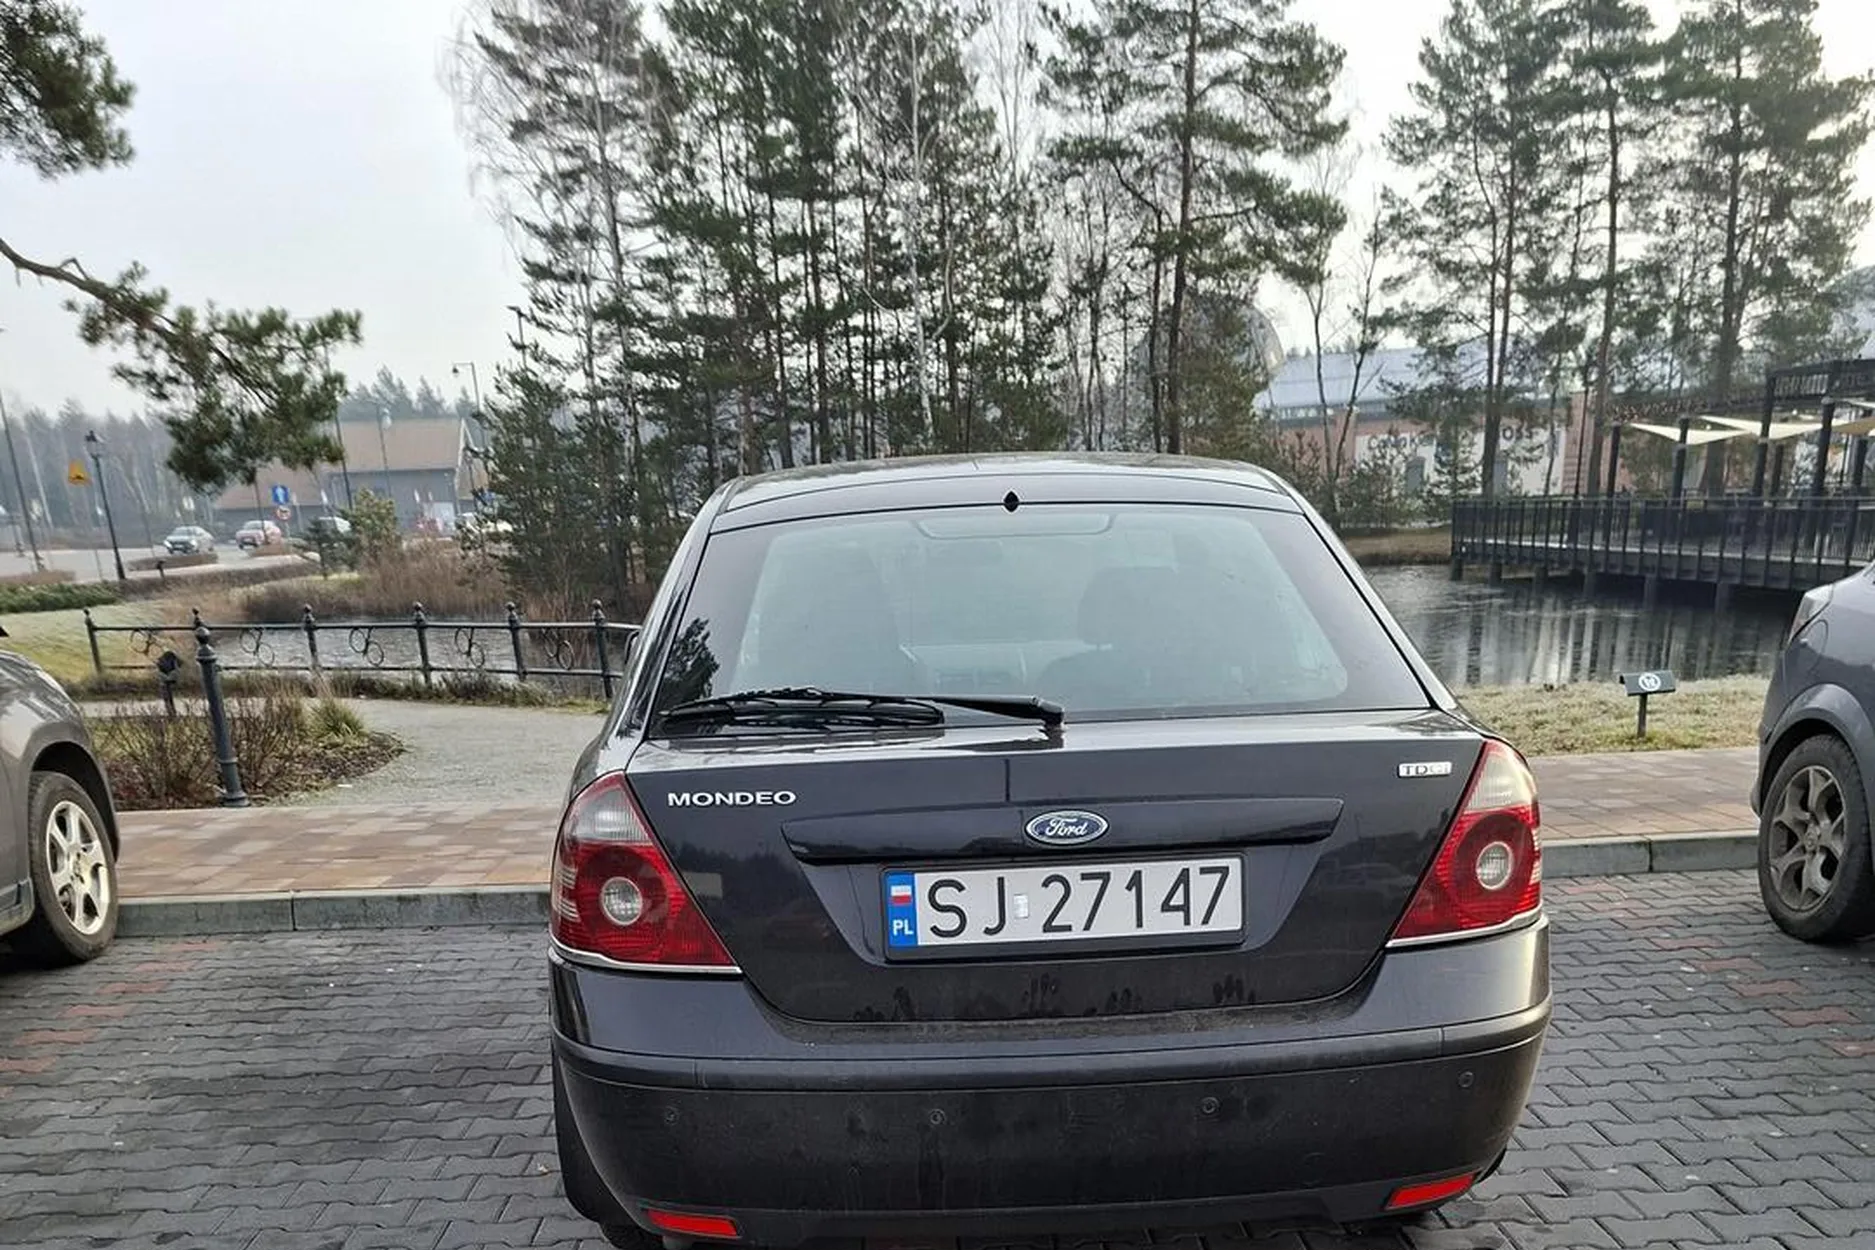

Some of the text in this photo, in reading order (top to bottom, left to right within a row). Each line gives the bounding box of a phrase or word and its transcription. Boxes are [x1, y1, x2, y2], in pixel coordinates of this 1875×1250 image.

[667, 790, 797, 807] MONDEO
[1045, 818, 1089, 836] Ford
[928, 866, 1231, 938] SJ 27147
[892, 919, 915, 936] PL
